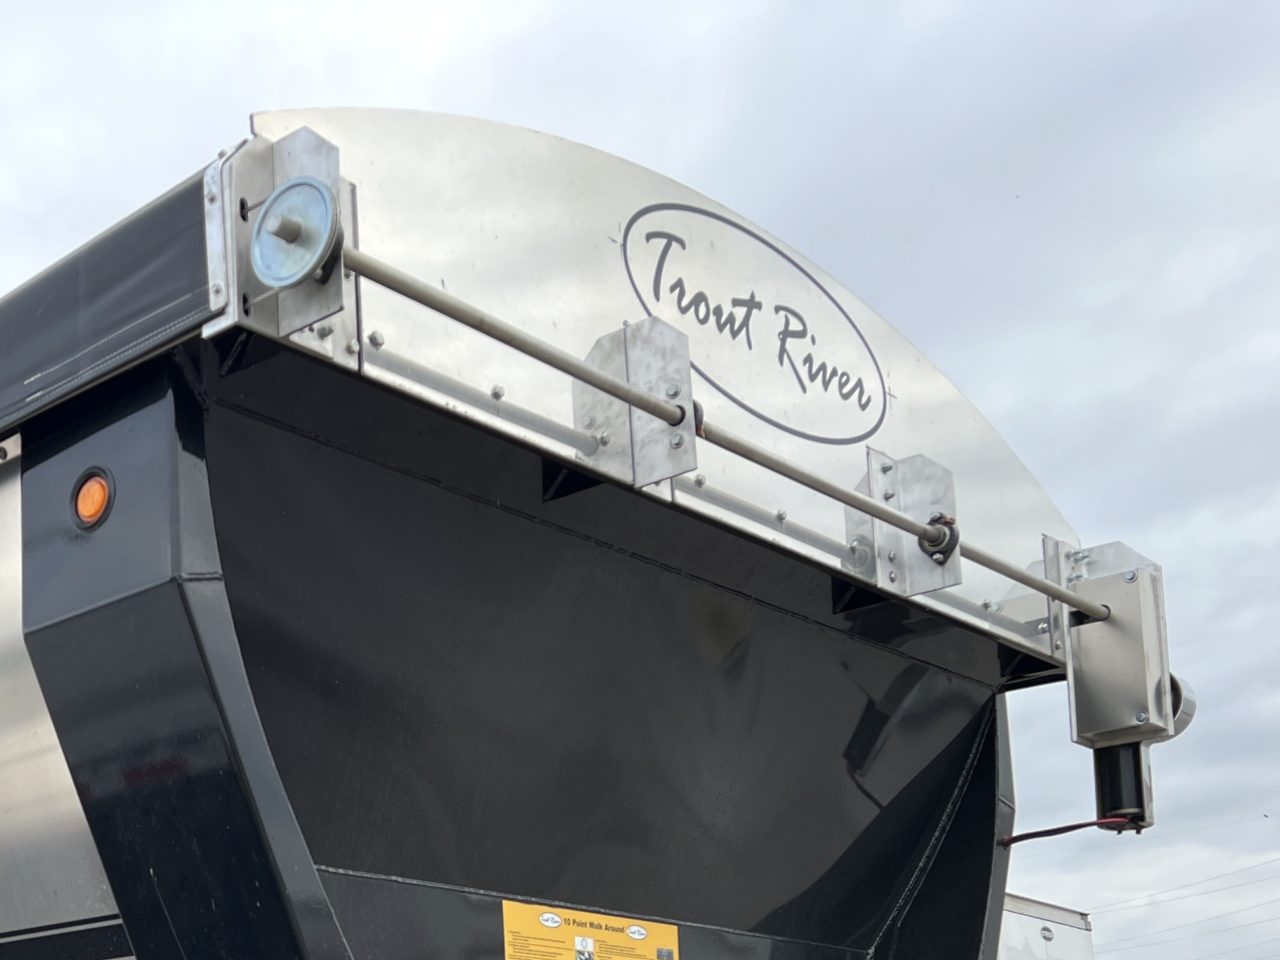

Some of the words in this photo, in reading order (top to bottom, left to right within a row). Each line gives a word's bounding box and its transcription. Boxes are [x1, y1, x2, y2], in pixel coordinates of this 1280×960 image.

[645, 230, 762, 350] Trout
[774, 304, 872, 412] River
[572, 919, 587, 929] Point
[589, 921, 603, 931] Walk
[605, 924, 625, 933] Around
